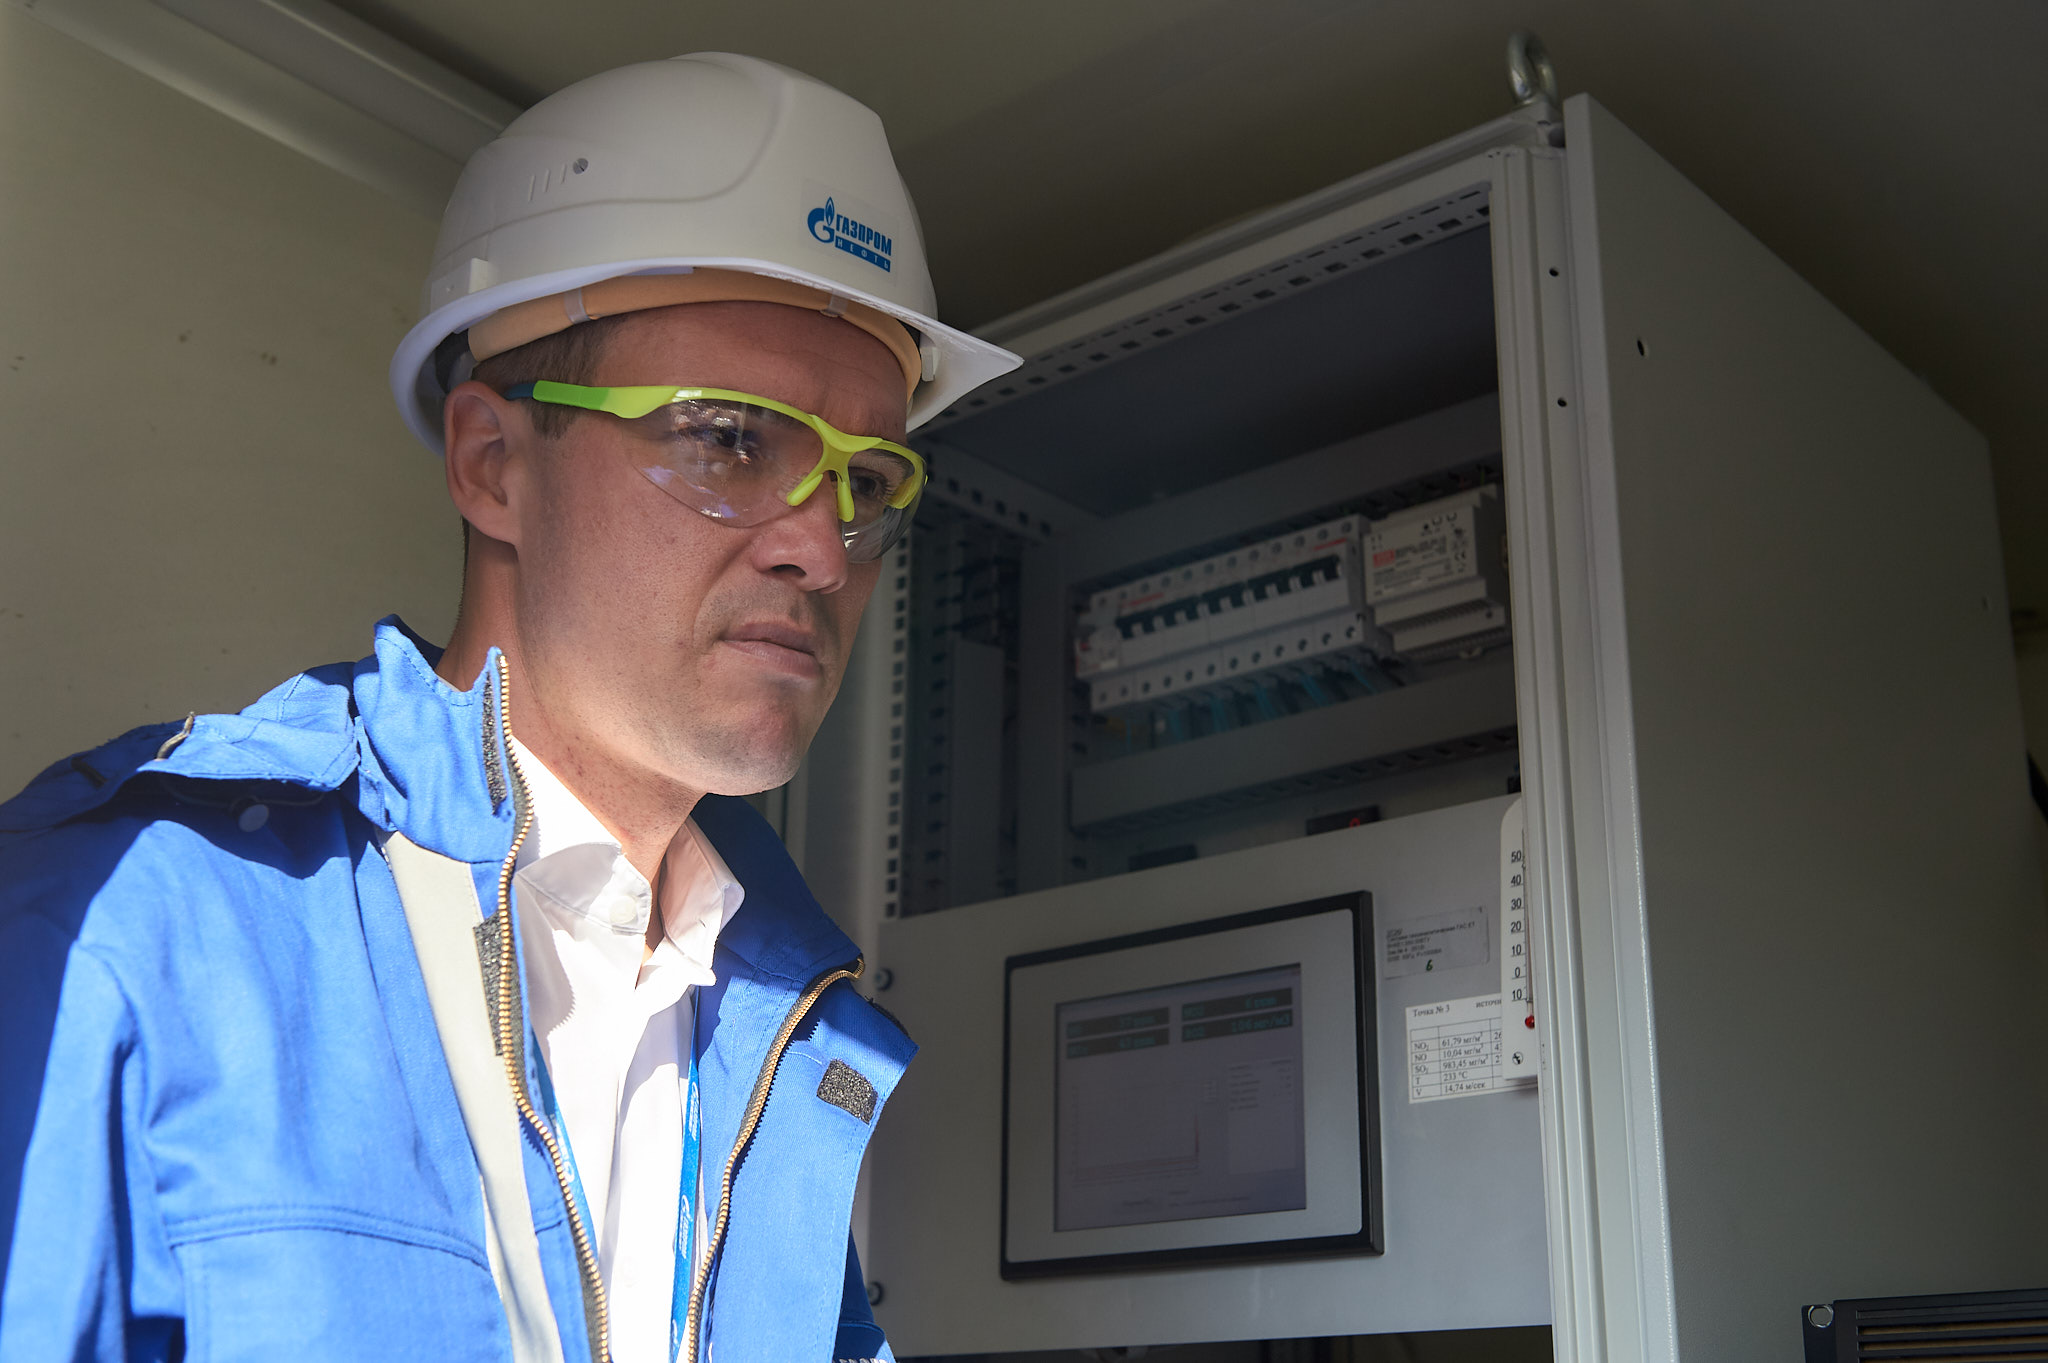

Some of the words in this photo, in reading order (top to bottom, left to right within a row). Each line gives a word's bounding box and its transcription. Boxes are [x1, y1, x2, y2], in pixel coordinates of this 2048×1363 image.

[836, 213, 892, 256] ГАЗПРОМ
[836, 238, 889, 270] НЕФТЬ
[1511, 850, 1522, 862] 50
[1511, 874, 1522, 886] 40
[1511, 898, 1522, 910] 30
[1510, 920, 1522, 932] 20
[1512, 944, 1522, 956] 10
[1514, 966, 1521, 978] 0
[1512, 988, 1522, 1000] 10
[1412, 1007, 1434, 1017] Точка
[1443, 1072, 1457, 1082] 233
[1416, 1088, 1422, 1096] V
[1444, 1082, 1464, 1094] 14,74
